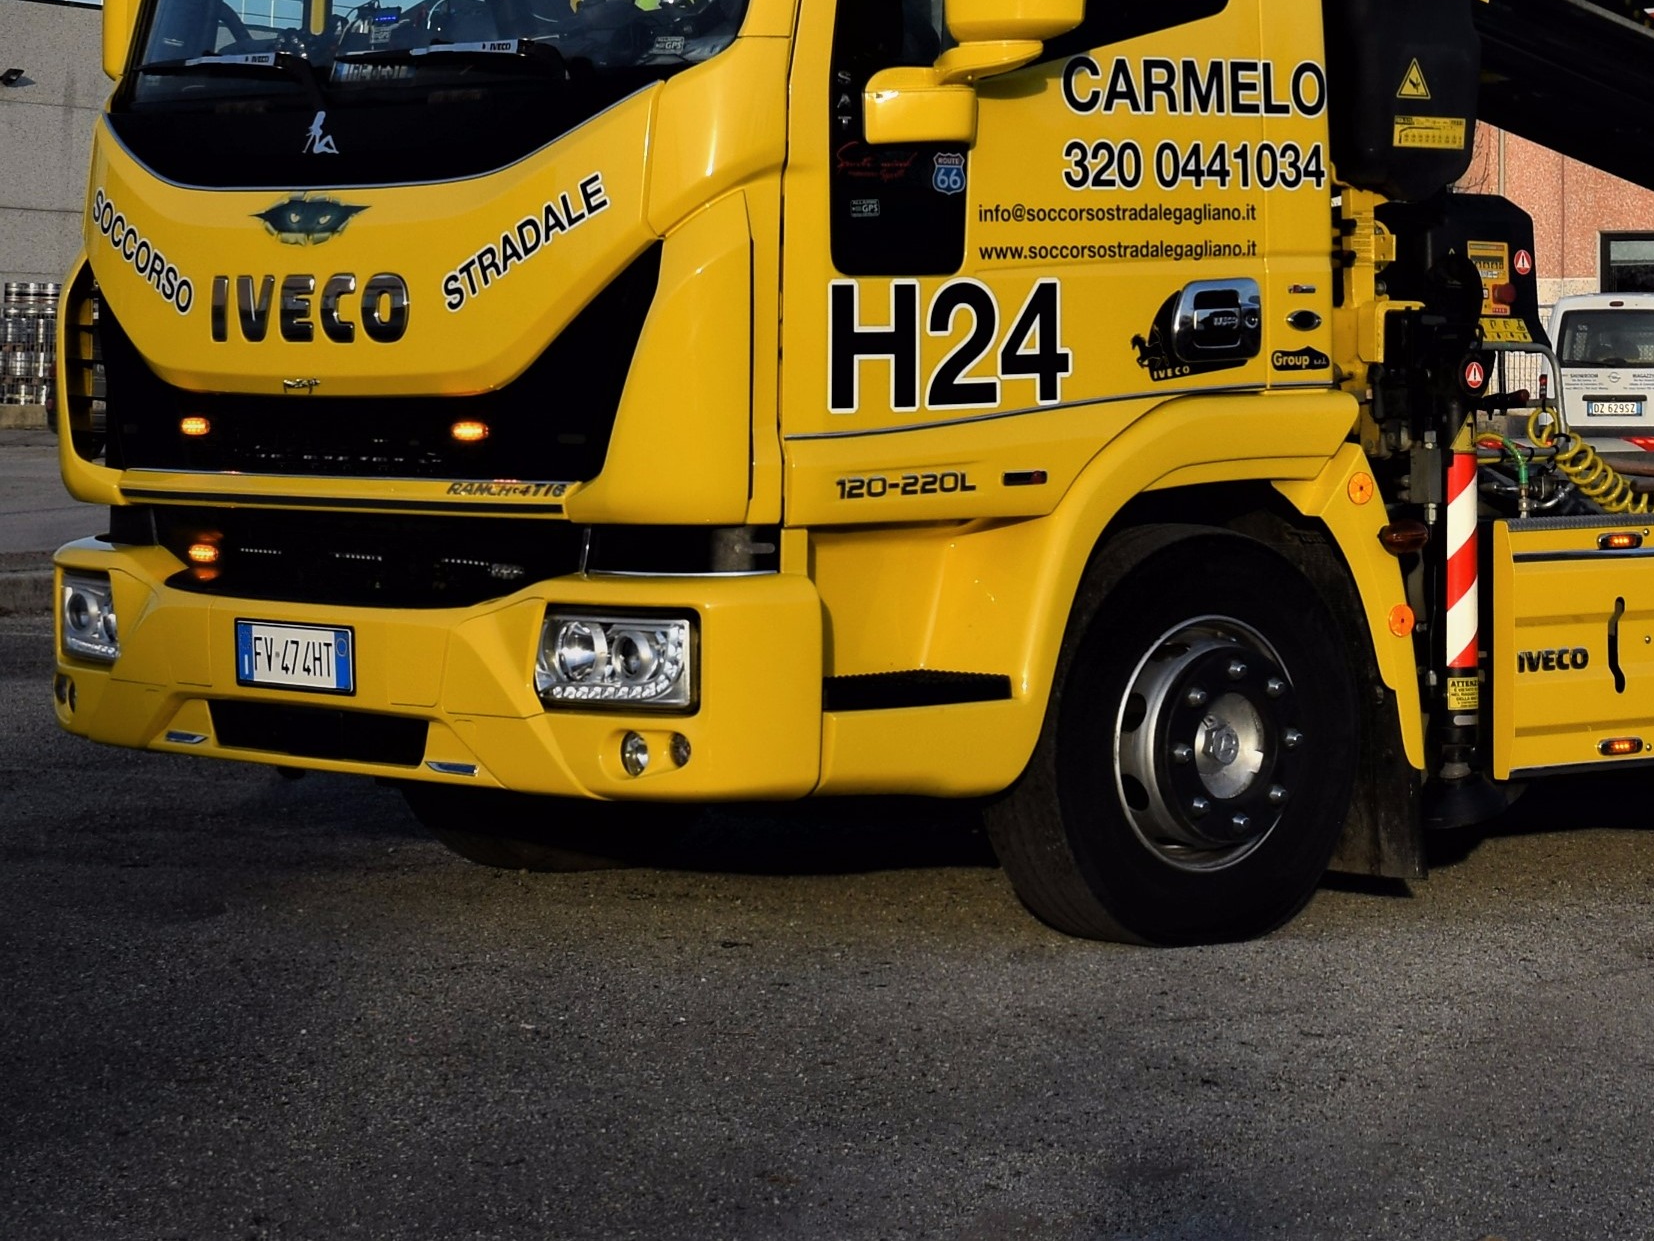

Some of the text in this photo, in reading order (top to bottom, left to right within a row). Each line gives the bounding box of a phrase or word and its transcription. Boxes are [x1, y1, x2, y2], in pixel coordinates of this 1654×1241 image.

[490, 42, 512, 52] IVECO
[1062, 57, 1326, 117] CARMELO
[938, 157, 961, 165] ROUTE
[1064, 140, 1325, 189] 320 0441034
[936, 168, 962, 190] 66
[862, 204, 878, 212] GPS
[978, 204, 1257, 225] info@soccorsostradalegagliano.it
[92, 189, 194, 315] SOCCORSO
[442, 174, 609, 312] STRADALE
[978, 240, 1258, 261] www.soccorsostradalegagliano.it
[210, 271, 411, 344] IVECO
[829, 280, 1072, 411] H24
[1273, 352, 1310, 368] Group
[1153, 365, 1191, 380] IVECO
[1608, 403, 1636, 413] 629SZ
[836, 471, 977, 500] 120-220L
[254, 636, 274, 672] FV
[281, 639, 333, 678] 474HT
[1516, 647, 1590, 674] IVECO
